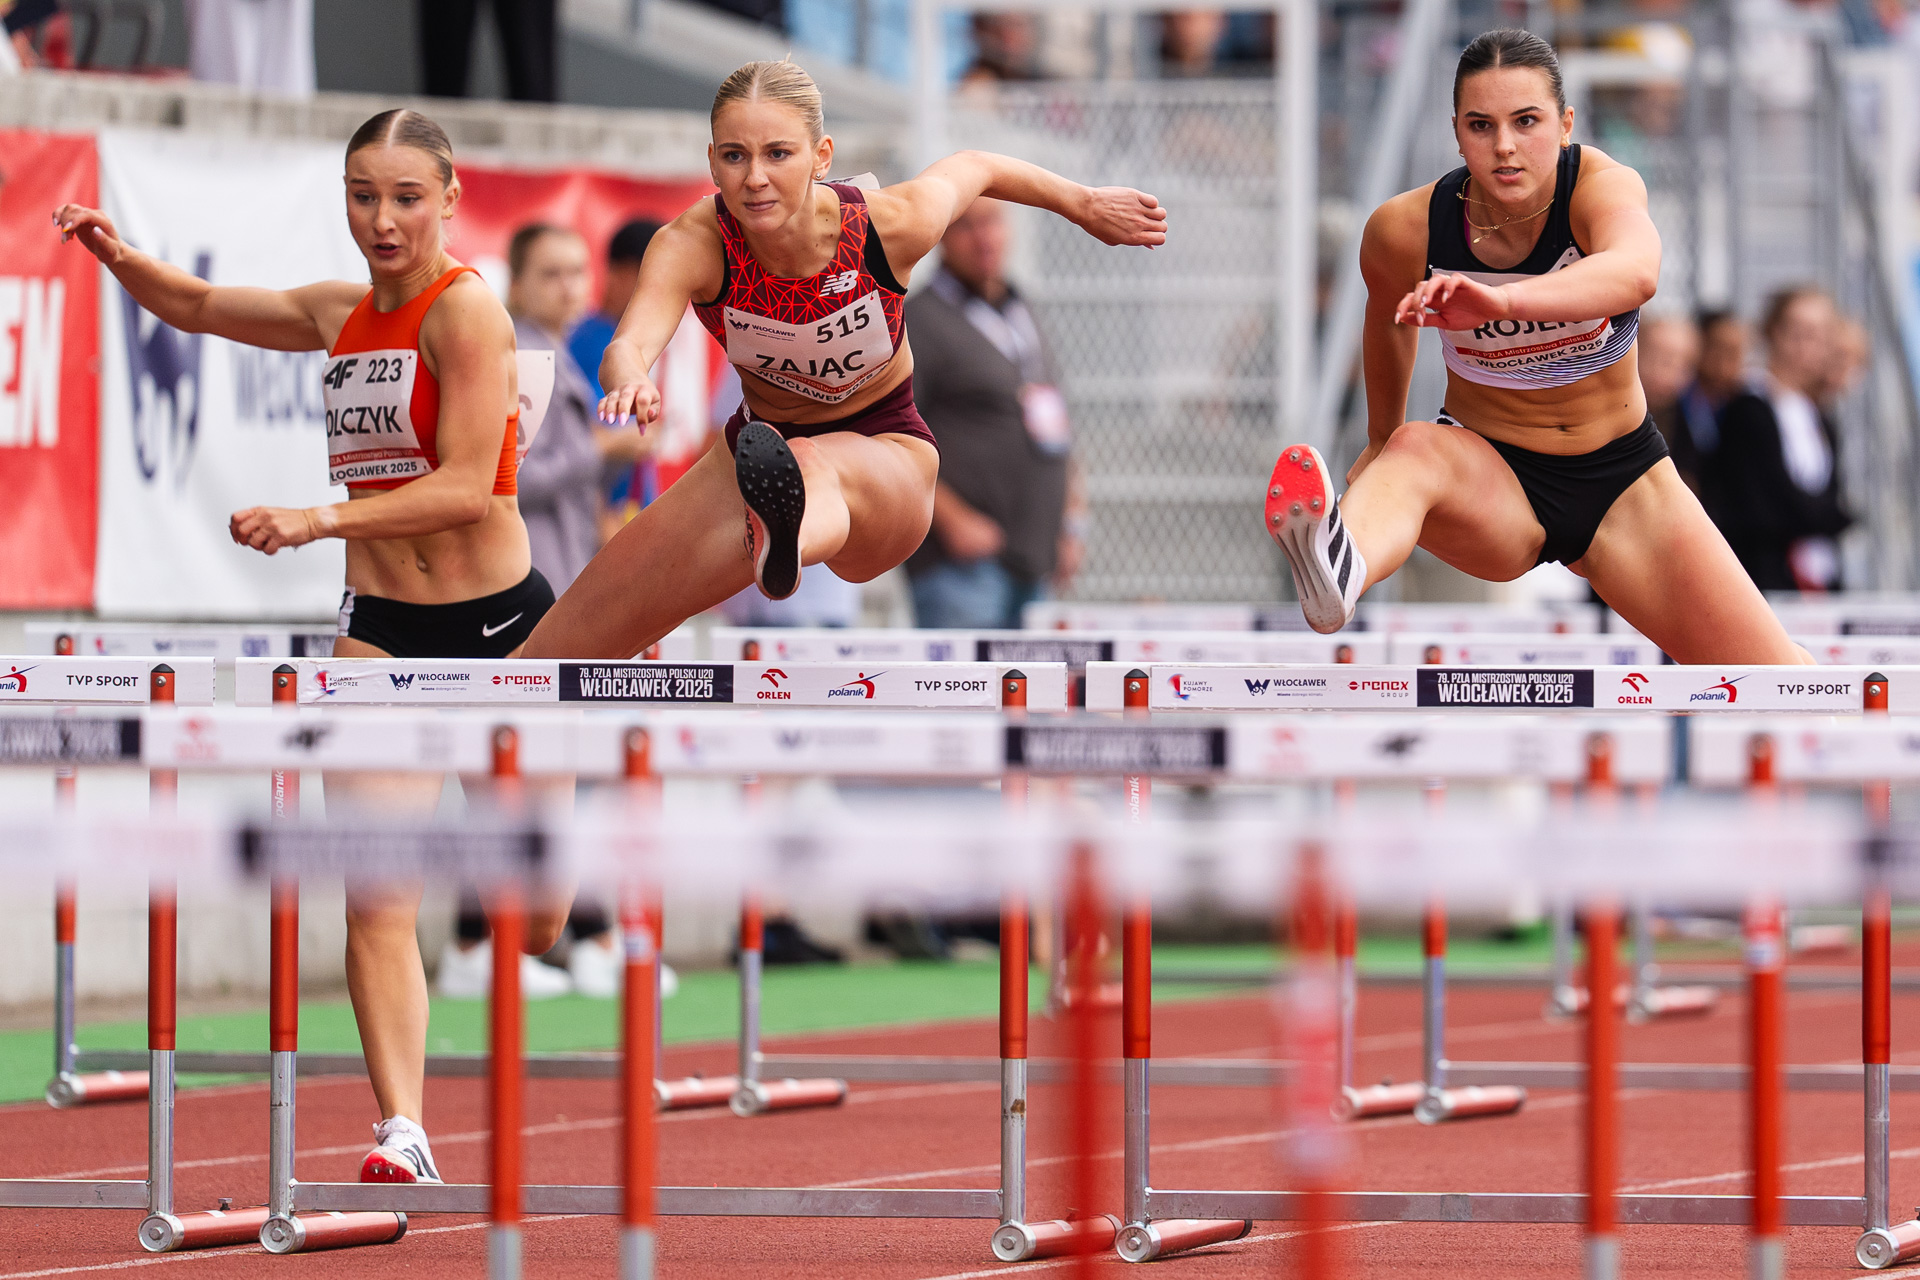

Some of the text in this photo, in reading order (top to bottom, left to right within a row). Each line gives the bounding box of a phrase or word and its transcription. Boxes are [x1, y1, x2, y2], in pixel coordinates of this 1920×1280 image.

[816, 304, 870, 344] 515
[1473, 319, 1582, 340] ROJE
[1483, 351, 1503, 359] PZLA
[1504, 343, 1558, 357] Mistrzostwa
[1559, 335, 1585, 346] Polski
[1586, 328, 1601, 340] U20
[1475, 338, 1603, 369] WŁOCŁAWEK 2025
[755, 349, 866, 379] ZAJĄC
[365, 357, 403, 384] 223
[755, 369, 843, 401] WŁOCŁAWEK
[390, 461, 418, 474] 2025
[417, 673, 471, 682] WŁOCŁAWEK
[579, 667, 714, 679] 79. PZLA MISTRZOSTWA POLSKI U20
[1437, 673, 1574, 684] 79. PZLA MISTRZOSTWA POLSKI U20
[66, 675, 139, 687] TVP SPORT
[914, 680, 988, 691] TVP SPORT
[1273, 678, 1327, 687] WŁOCŁAWEK
[579, 678, 714, 698] WŁOCŁAWEK 2025
[827, 687, 865, 699] polanik
[1437, 683, 1574, 703] WŁOCŁAWEK 2025
[1777, 684, 1851, 695] TVP SPORT
[756, 691, 791, 700] ORLEN
[1617, 696, 1653, 704] ORLEN
[1689, 691, 1727, 702] polanik
